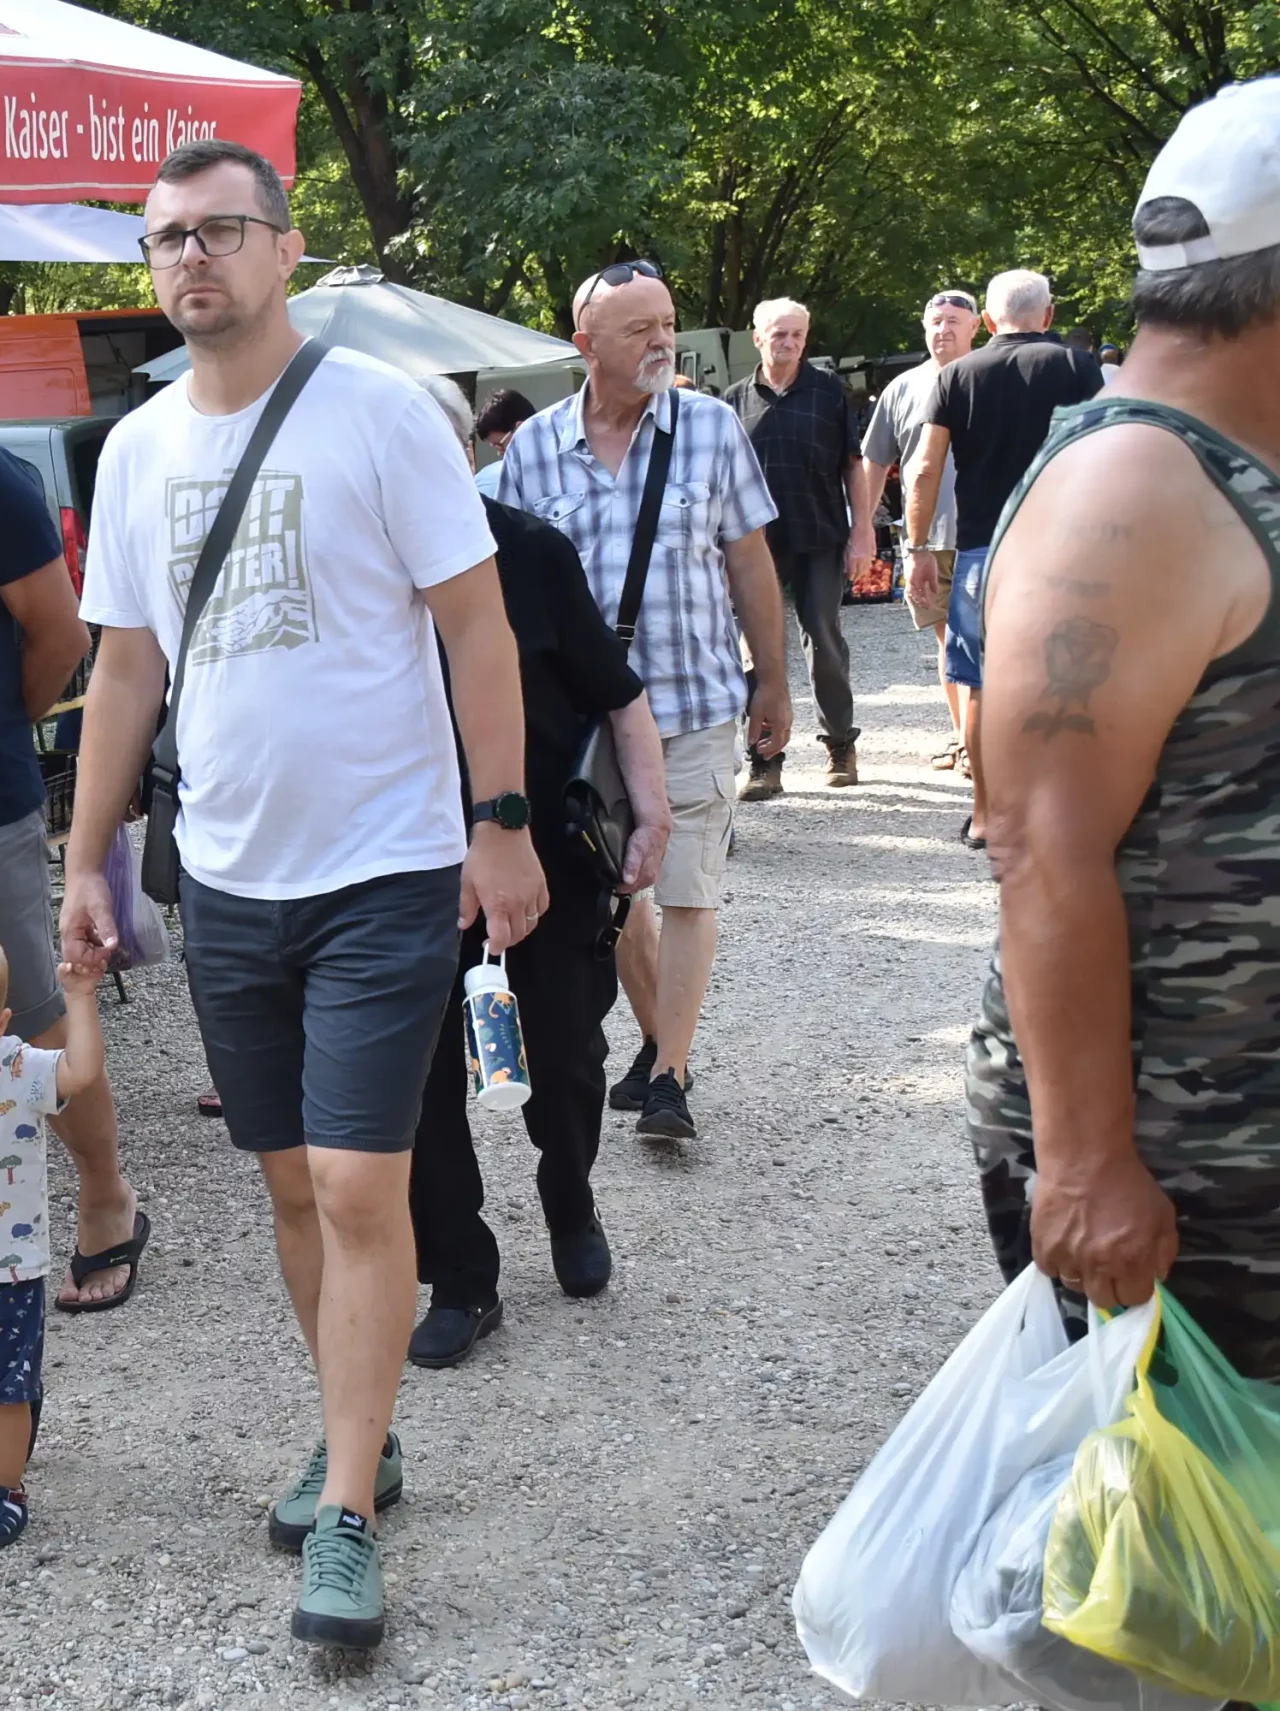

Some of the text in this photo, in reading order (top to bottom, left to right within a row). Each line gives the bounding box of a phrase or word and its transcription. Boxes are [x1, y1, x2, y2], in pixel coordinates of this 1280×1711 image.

[4, 92, 68, 159] Kaiser
[89, 94, 125, 161] bist
[132, 102, 159, 162] ein
